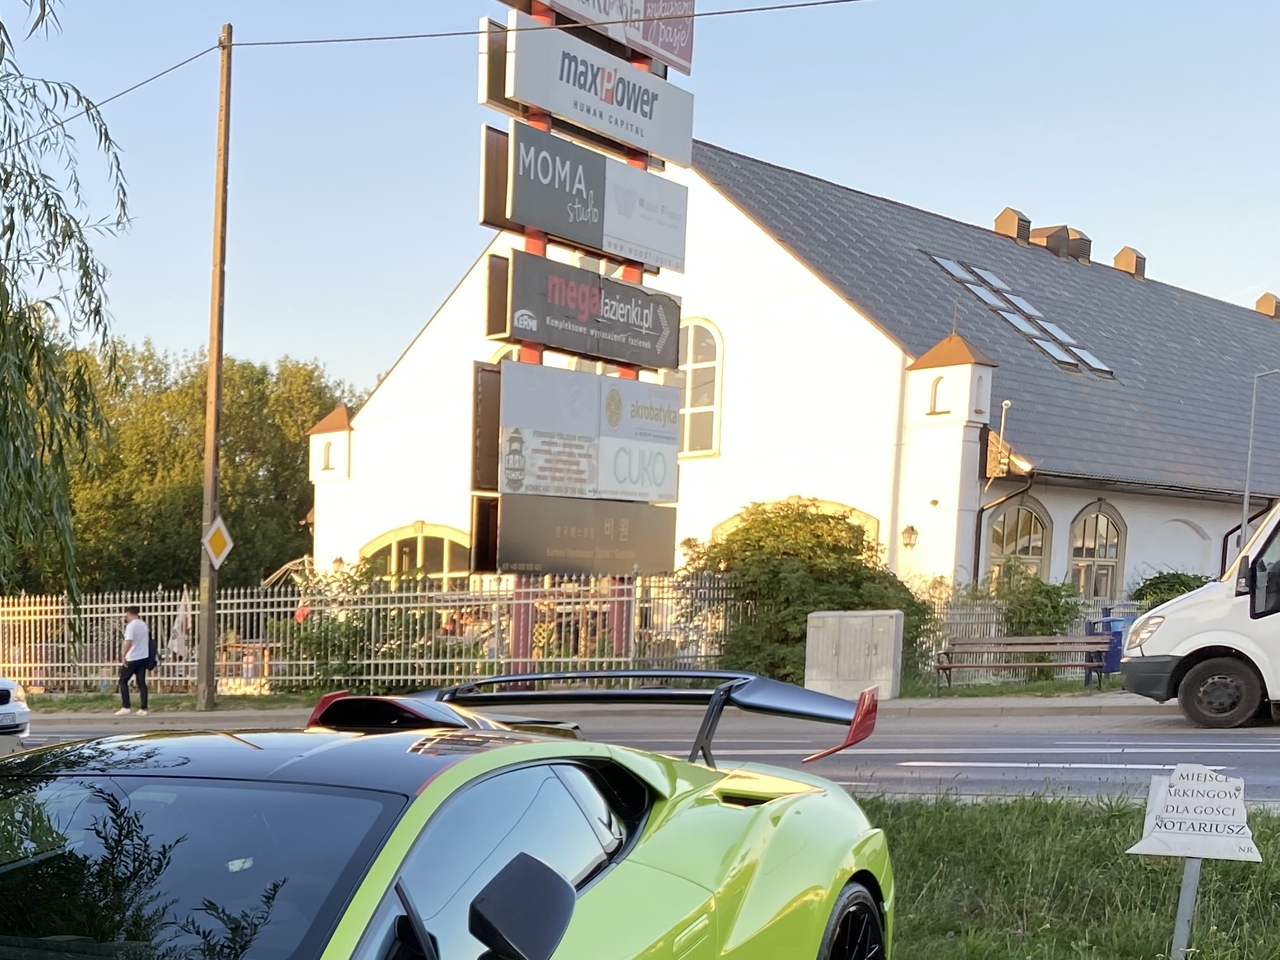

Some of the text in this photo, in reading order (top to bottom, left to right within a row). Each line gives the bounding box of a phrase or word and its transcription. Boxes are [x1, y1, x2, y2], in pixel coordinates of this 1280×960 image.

[559, 50, 659, 121] maxPower
[572, 99, 645, 138] HUMAN CAPITAL
[518, 141, 588, 199] MOMA
[566, 189, 600, 225] studio
[513, 314, 538, 332] KERMI
[545, 315, 587, 336] Kompleksowe
[630, 400, 678, 428] akrobatyka
[613, 446, 668, 488] CUKO
[1165, 804, 1190, 815] DLA
[1155, 820, 1246, 836] NOTARIUSZ
[1237, 846, 1253, 854] NR
